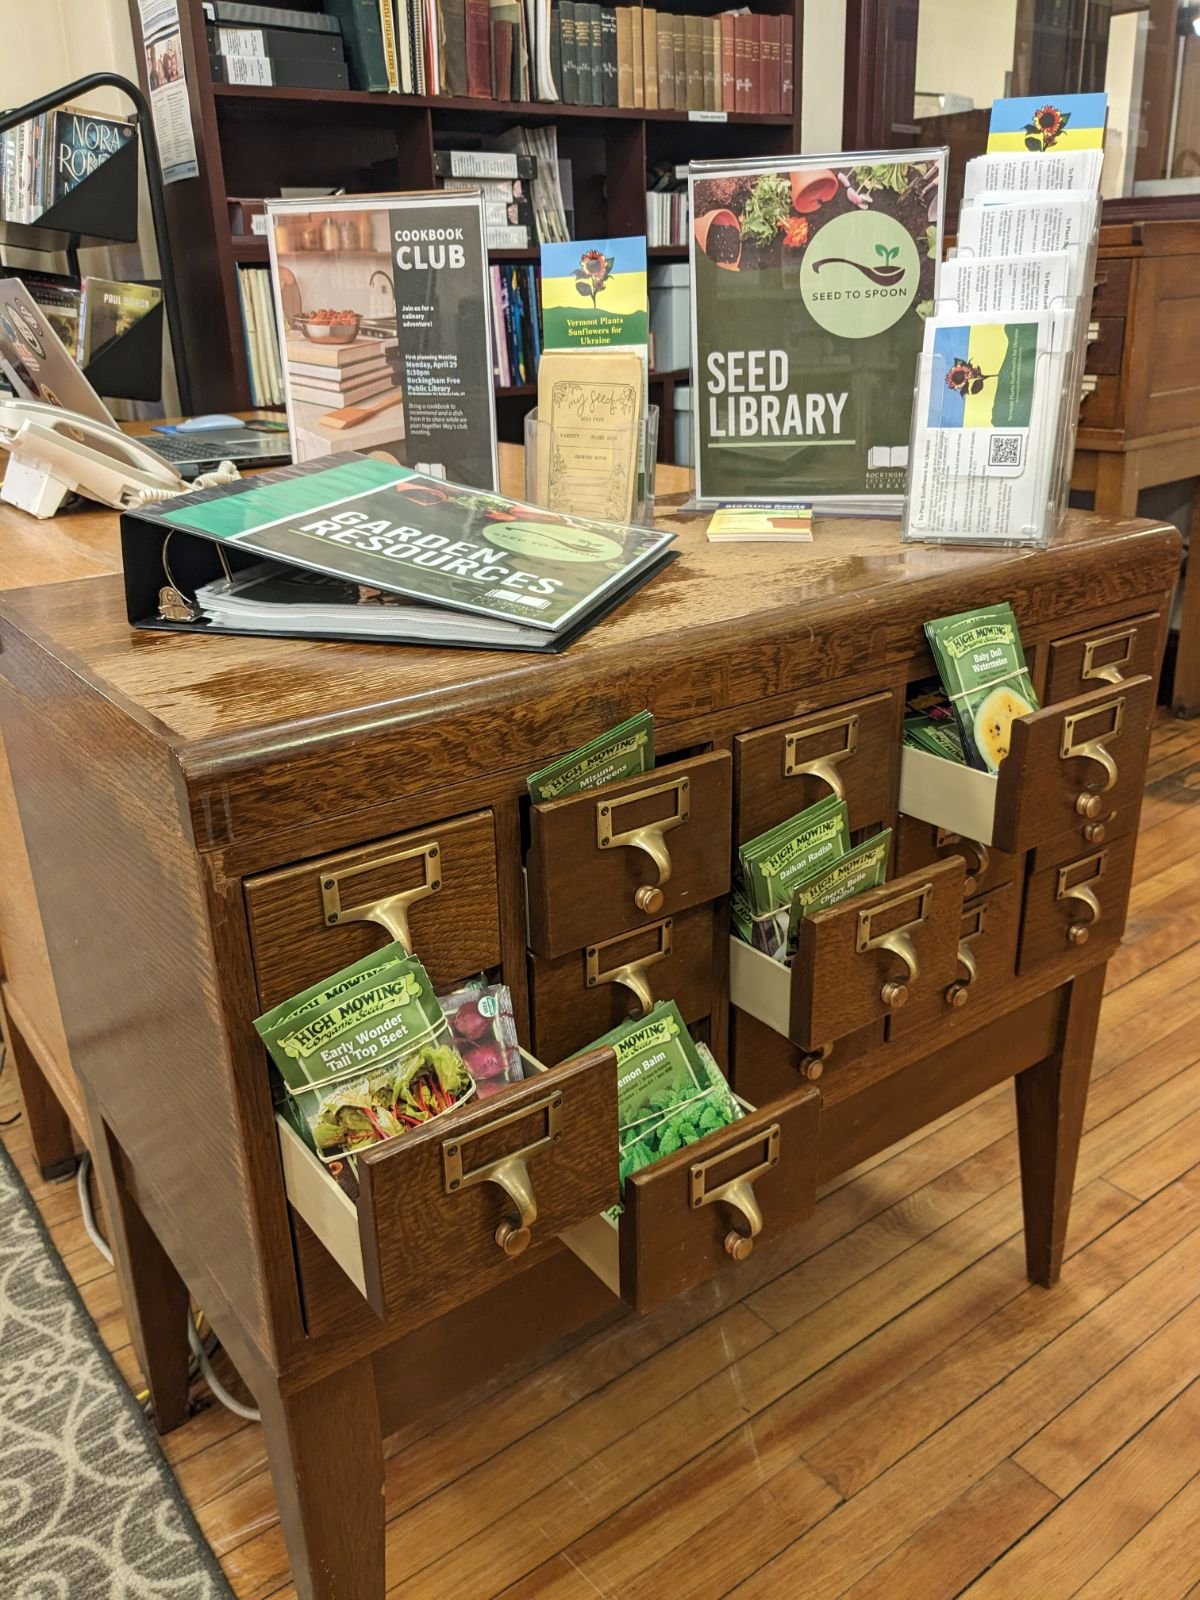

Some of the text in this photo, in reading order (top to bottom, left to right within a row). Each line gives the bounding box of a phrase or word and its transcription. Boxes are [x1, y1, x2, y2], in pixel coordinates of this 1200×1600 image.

[72, 116, 120, 154] NORA
[394, 228, 464, 242] COOKBOOK
[396, 244, 466, 270] CLUB
[104, 293, 121, 304] PAUL
[812, 288, 907, 301] SEED TO SPOON
[568, 328, 609, 336] Sunflowers
[407, 377, 446, 385] Rockingham
[433, 361, 448, 369] April
[707, 350, 789, 394] SEED
[709, 392, 848, 437] LIBRARY
[330, 512, 508, 564] GARDEN
[300, 520, 564, 594] RESOURCES
[953, 626, 1006, 649] HIGH MOWING
[972, 658, 1008, 673] Watermelon
[973, 648, 1002, 663] Baby Doll
[551, 736, 636, 789] HIGH MOWING
[579, 764, 615, 789] Mizuna
[596, 763, 628, 787] Greens
[769, 820, 835, 867] HIGH MOWING
[780, 860, 807, 880] Daikon
[807, 843, 833, 862] Radish
[809, 874, 835, 898] HIGH
[837, 850, 876, 877] MOWING
[820, 873, 866, 904] Cherry Belle
[294, 981, 404, 1047] HIGH MOWING
[306, 1000, 391, 1050] Organic Seeds
[320, 1013, 403, 1062] Early Wonder
[326, 1055, 352, 1072] Tall
[352, 1044, 378, 1061] Top
[379, 1025, 409, 1048] Beet
[618, 1023, 666, 1053] MOWING
[617, 1067, 642, 1089] emon
[642, 1051, 666, 1071] Balm
